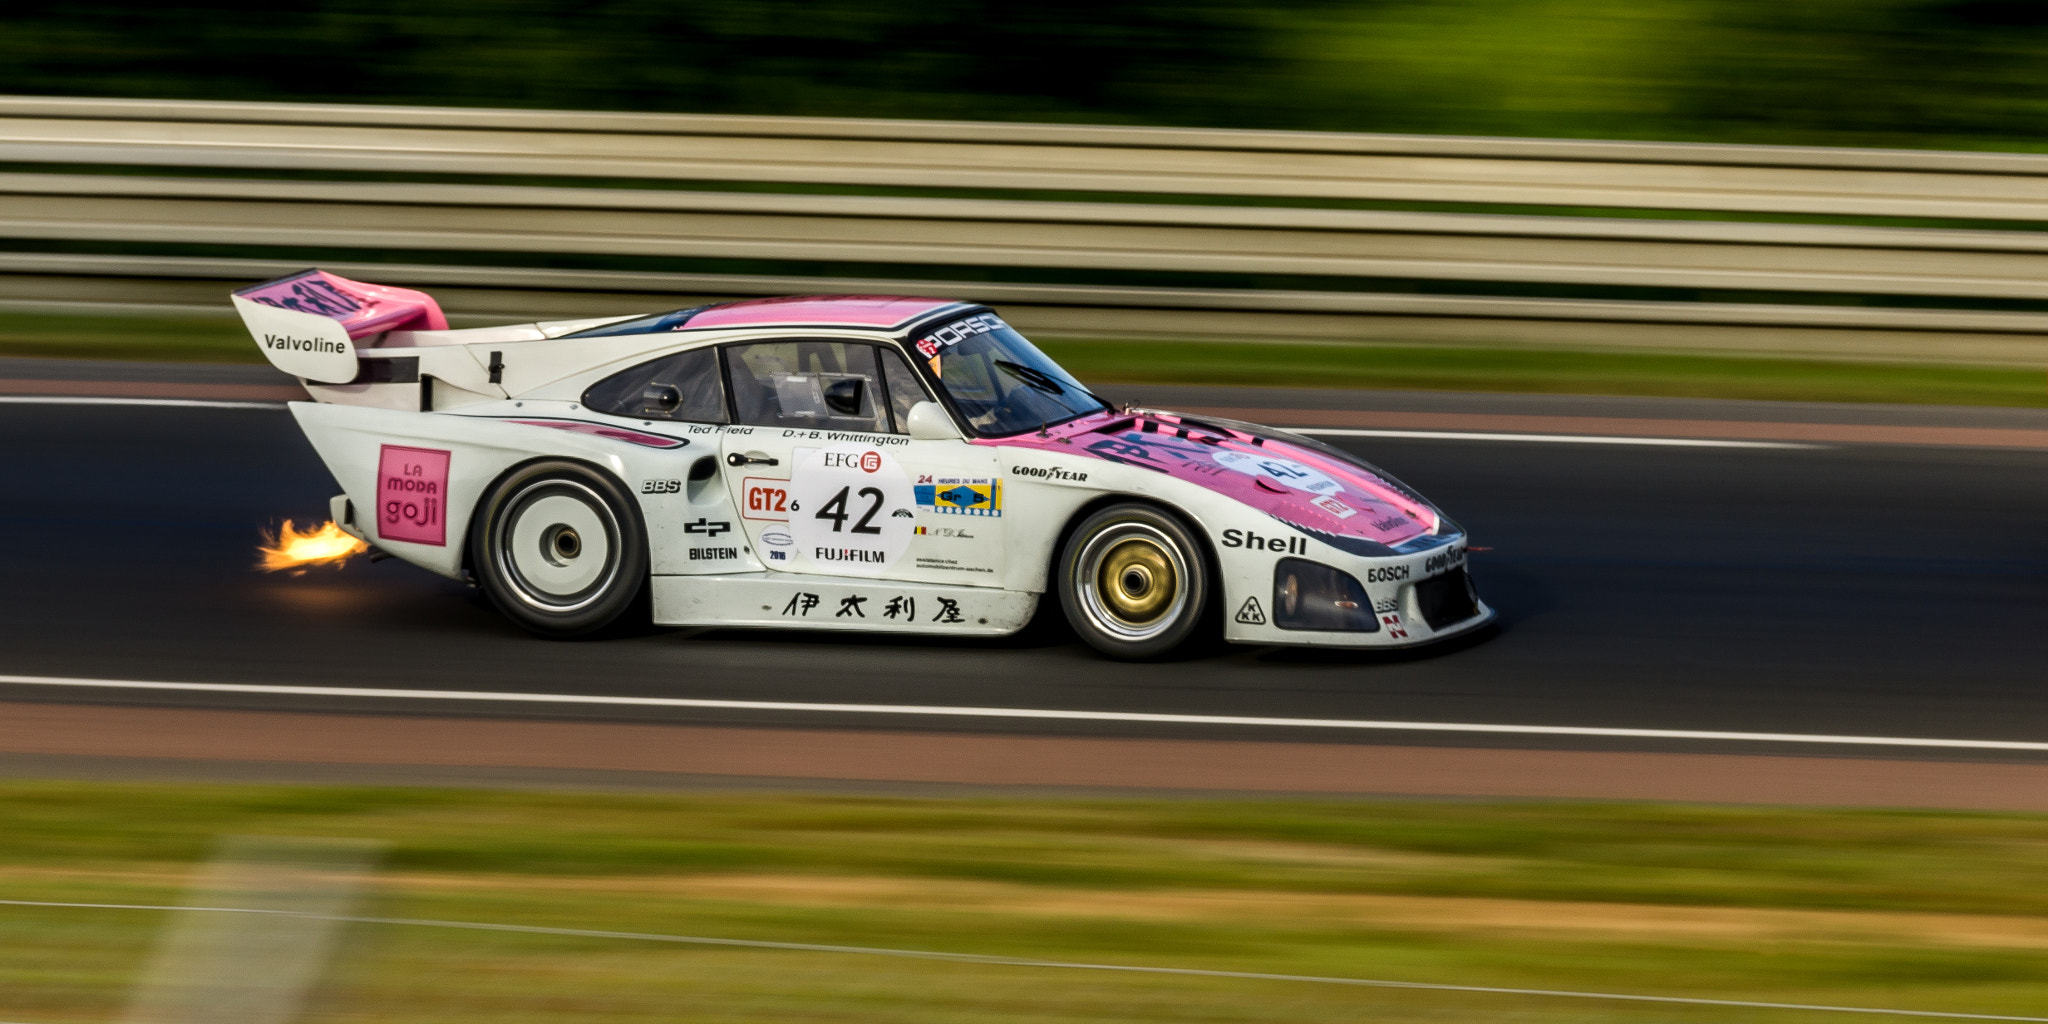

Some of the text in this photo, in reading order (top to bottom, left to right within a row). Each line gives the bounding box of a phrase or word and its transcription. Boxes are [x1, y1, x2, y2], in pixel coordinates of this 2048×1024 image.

[264, 334, 346, 354] Valvoline
[688, 425, 754, 435] Ted Field
[827, 432, 910, 446] Whittington
[824, 452, 859, 468] EFG
[403, 463, 423, 477] LA
[1257, 461, 1308, 480] 42
[387, 477, 437, 494] MODA
[641, 479, 681, 494] BBS
[917, 474, 933, 484] 24
[749, 486, 787, 512] GT2
[940, 490, 962, 502] Gr
[386, 497, 437, 526] goji
[790, 499, 800, 512] 6
[815, 485, 885, 535] 42
[1222, 528, 1307, 556] Shell
[689, 546, 738, 561] BILSTEIN
[770, 550, 786, 560] 2016
[816, 546, 885, 564] FUJIFILM
[1368, 564, 1409, 583] BOSCH
[782, 591, 966, 624] 伊太利屋
